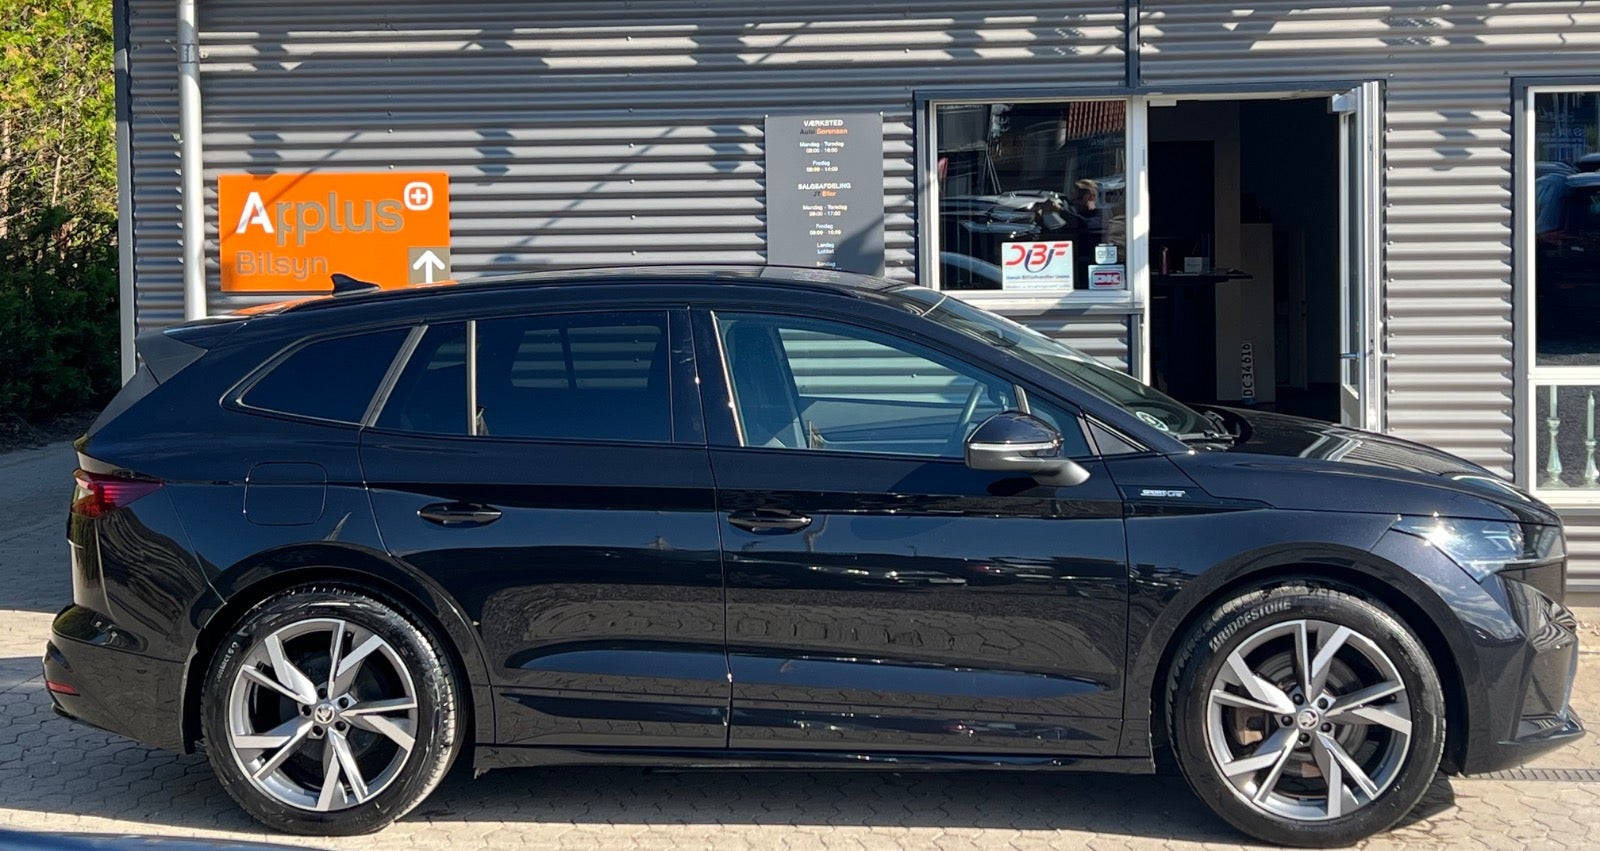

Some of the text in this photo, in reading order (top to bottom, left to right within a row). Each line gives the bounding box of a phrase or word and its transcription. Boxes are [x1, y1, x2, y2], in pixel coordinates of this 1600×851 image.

[235, 251, 328, 280] Bilsyn
[1243, 381, 1253, 396] DC
[1208, 597, 1292, 653] BRIDGESTONE
